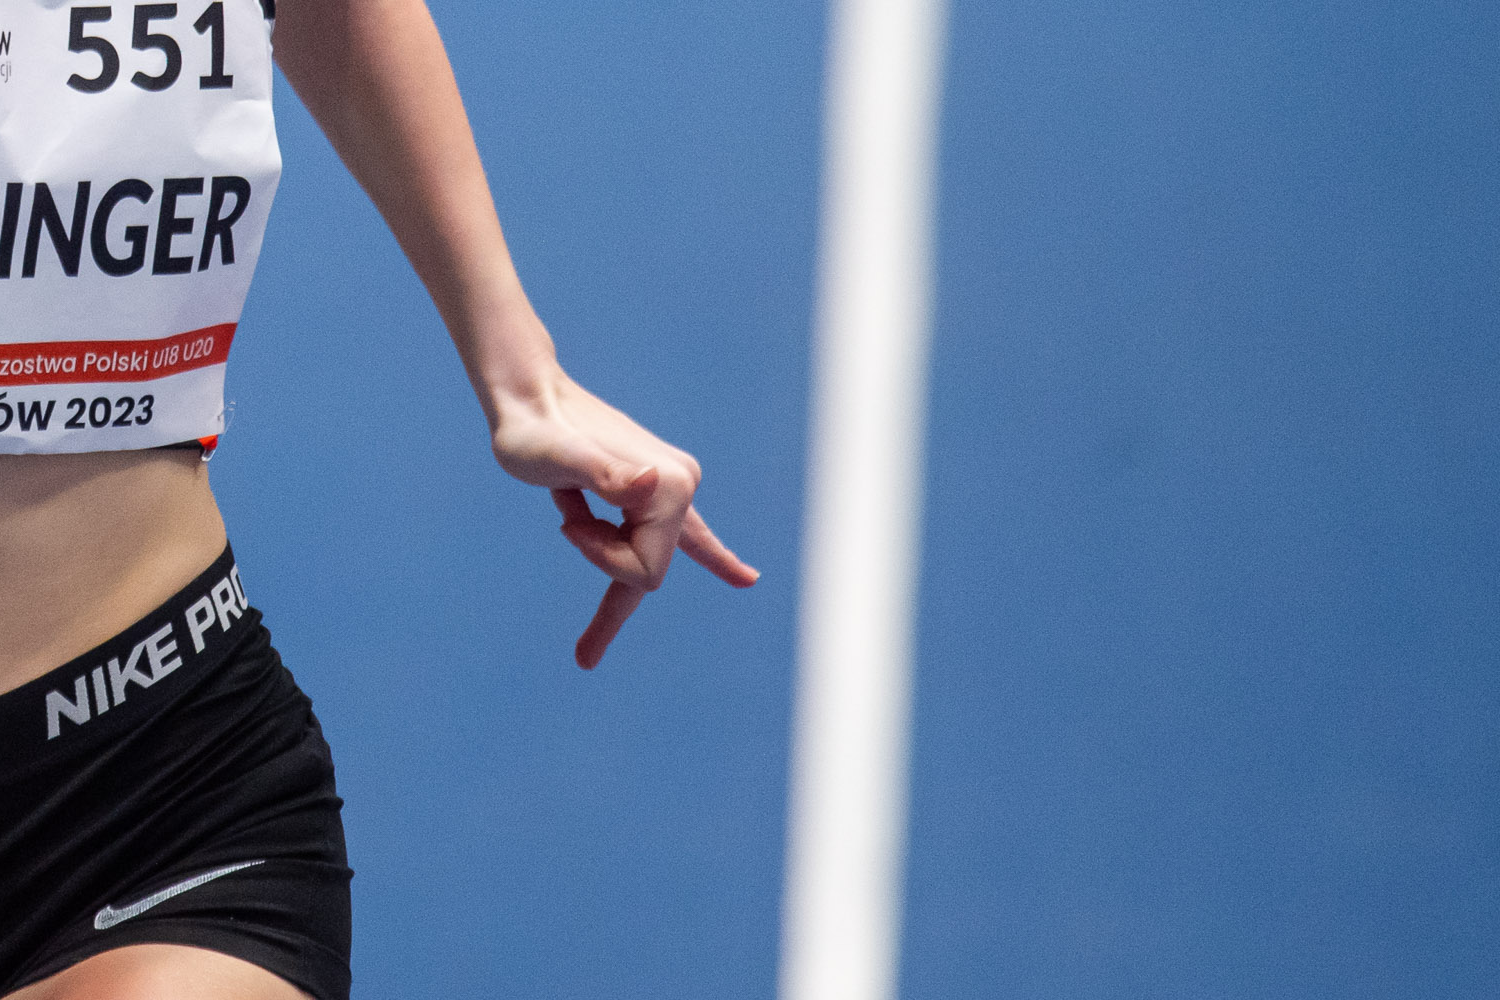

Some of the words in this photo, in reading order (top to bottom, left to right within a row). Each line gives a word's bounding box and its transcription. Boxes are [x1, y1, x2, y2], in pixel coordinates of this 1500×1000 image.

[66, 1, 234, 94] 551
[83, 351, 149, 374] Polski
[152, 344, 179, 369] U18
[183, 336, 214, 362] U20
[64, 394, 154, 430] 2023
[45, 622, 183, 740] NIKE
